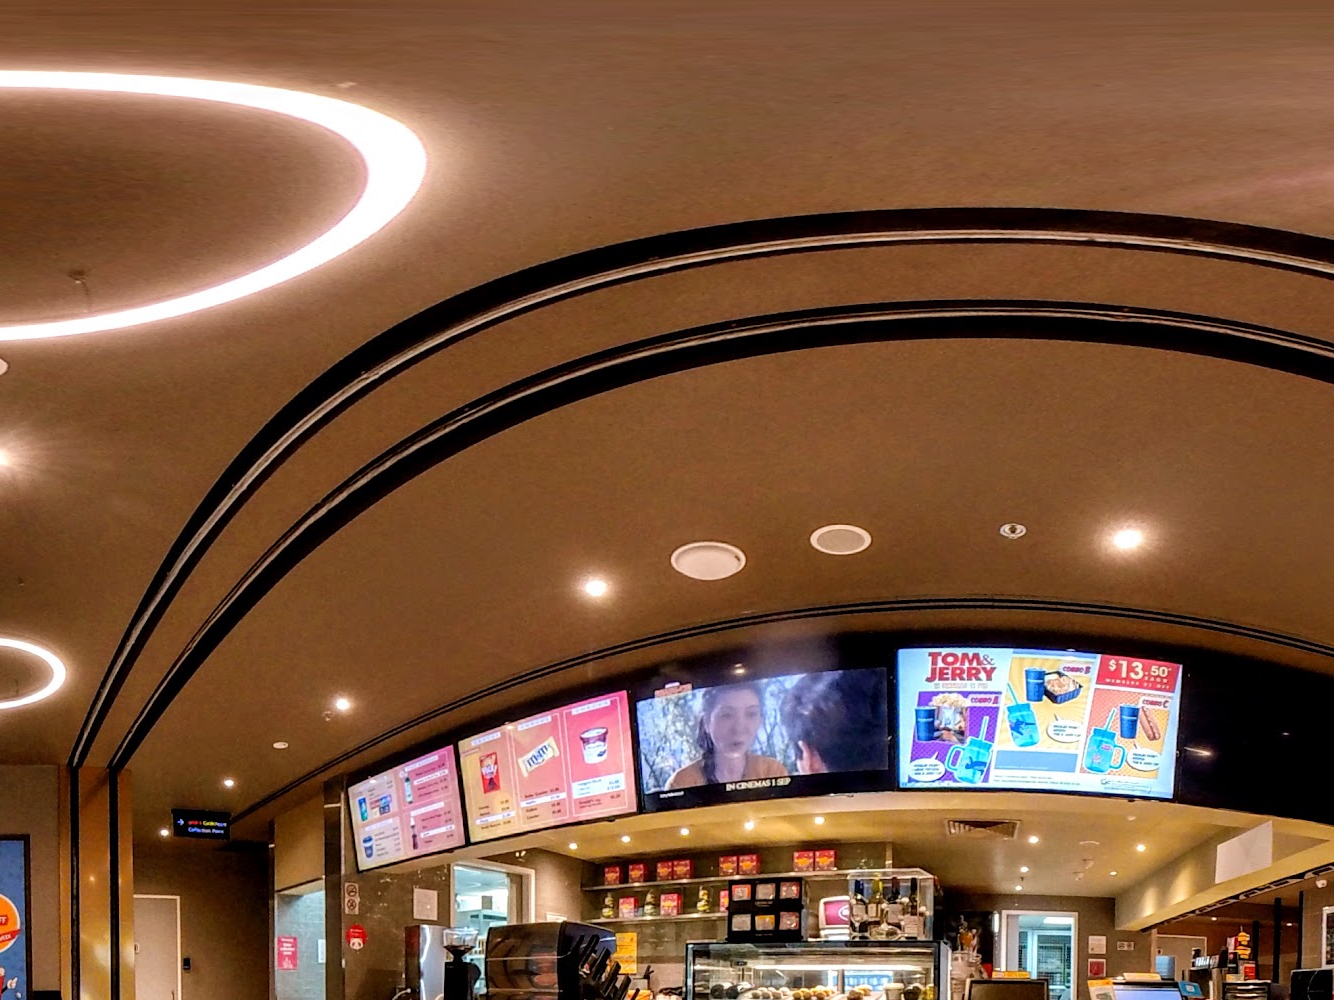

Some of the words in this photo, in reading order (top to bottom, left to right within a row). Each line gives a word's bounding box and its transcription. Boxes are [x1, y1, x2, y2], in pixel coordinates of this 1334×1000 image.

[928, 652, 982, 666] TOM
[981, 655, 995, 665] &
[925, 667, 996, 682] JERRY
[726, 784, 735, 792] IN
[736, 780, 770, 791] CINEMAS
